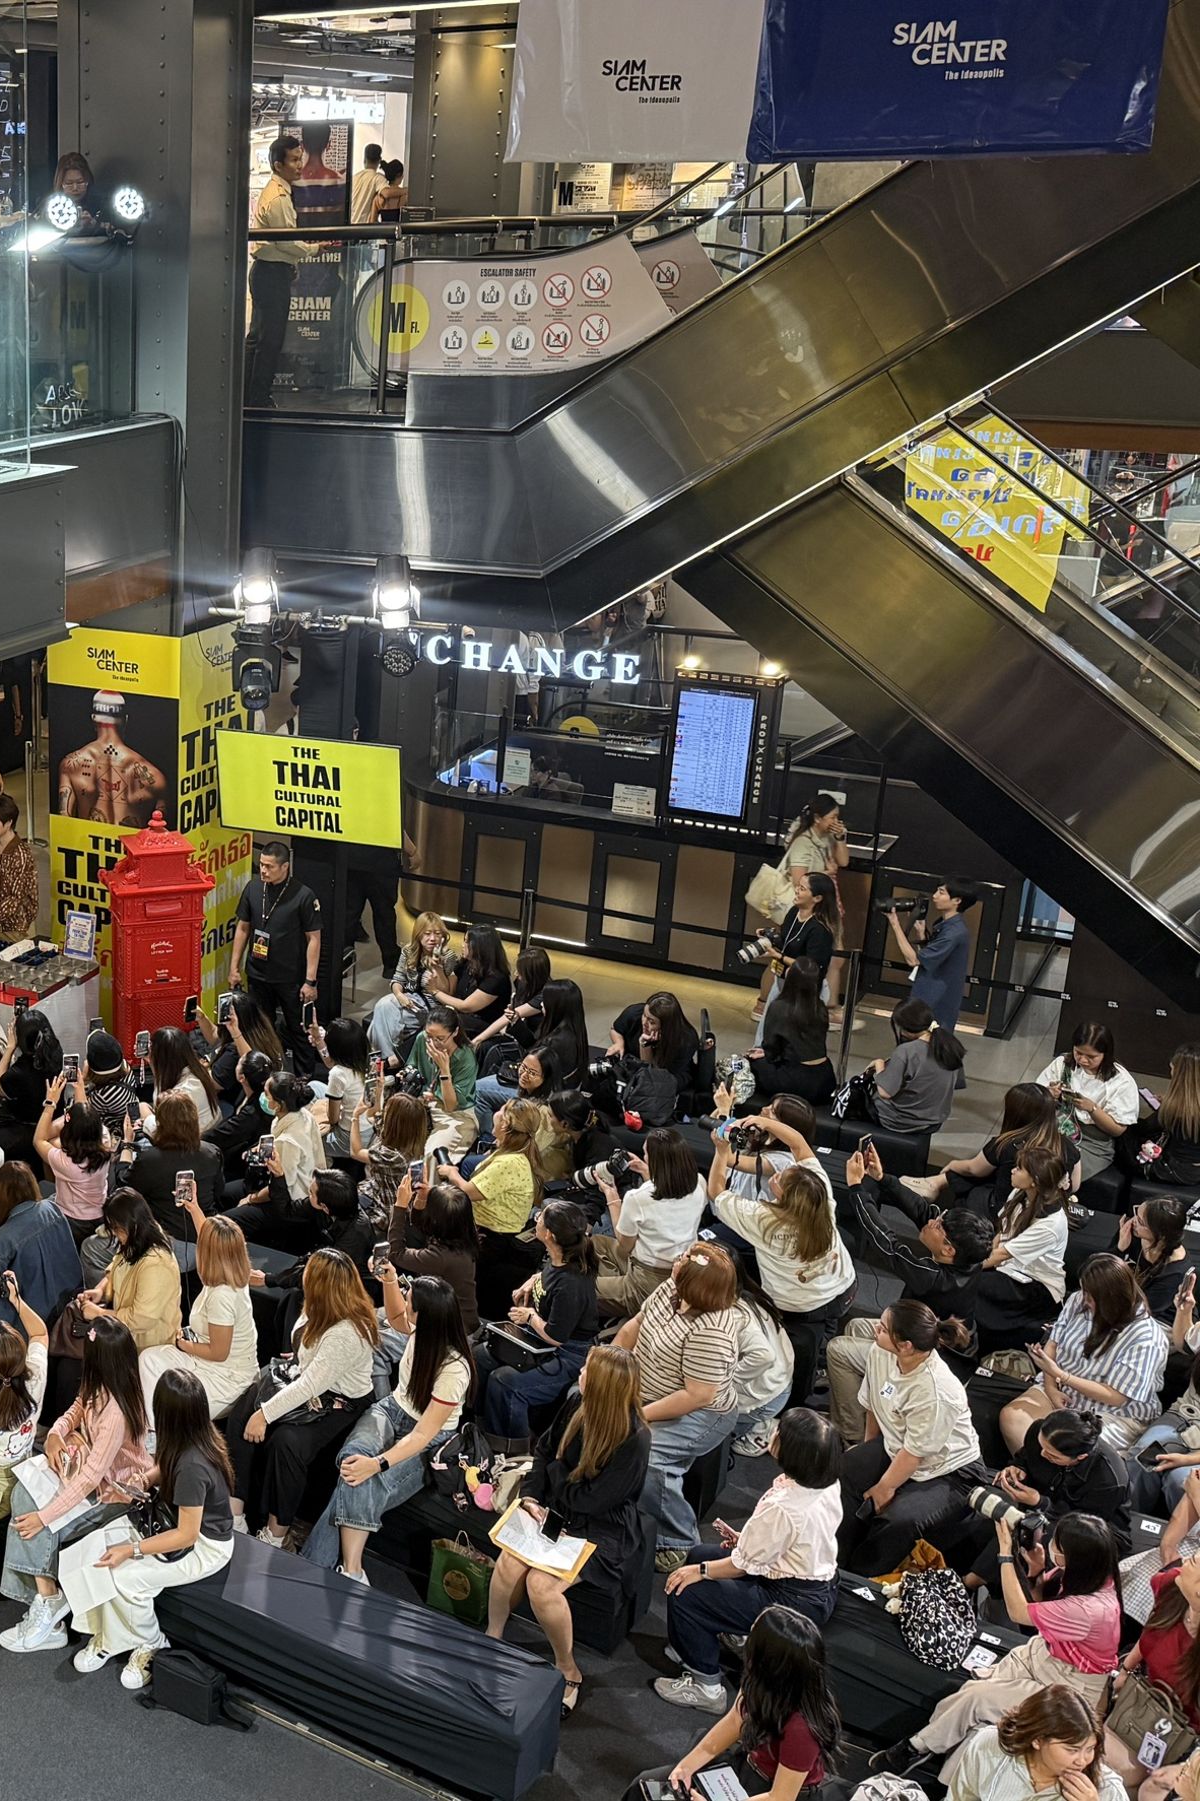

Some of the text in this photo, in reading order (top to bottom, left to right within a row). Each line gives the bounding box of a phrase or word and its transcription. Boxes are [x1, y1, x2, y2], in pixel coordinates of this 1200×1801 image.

[892, 19, 957, 46] SIAM
[911, 38, 1008, 66] CENTER
[601, 59, 647, 76] SIAM
[944, 68, 1005, 80] The Ideaopolis
[615, 74, 682, 92] CENTER
[638, 96, 648, 104] The
[480, 268, 537, 277] ESCALATOR SAFETY
[289, 296, 332, 310] SIAM
[288, 310, 331, 321] CENTER
[87, 647, 115, 660] SIAM
[211, 652, 233, 665] CENTE
[409, 633, 641, 685] CHANGE
[96, 660, 139, 674] CENTER
[204, 694, 236, 721] THE
[291, 746, 320, 760] THE
[180, 765, 217, 796] CULT
[272, 760, 341, 791] THAI
[274, 789, 342, 808] CULTURAL
[275, 805, 343, 834] CAPITAL
[89, 834, 128, 855] TH
[57, 847, 119, 884] TH
[57, 880, 110, 903] CULT
